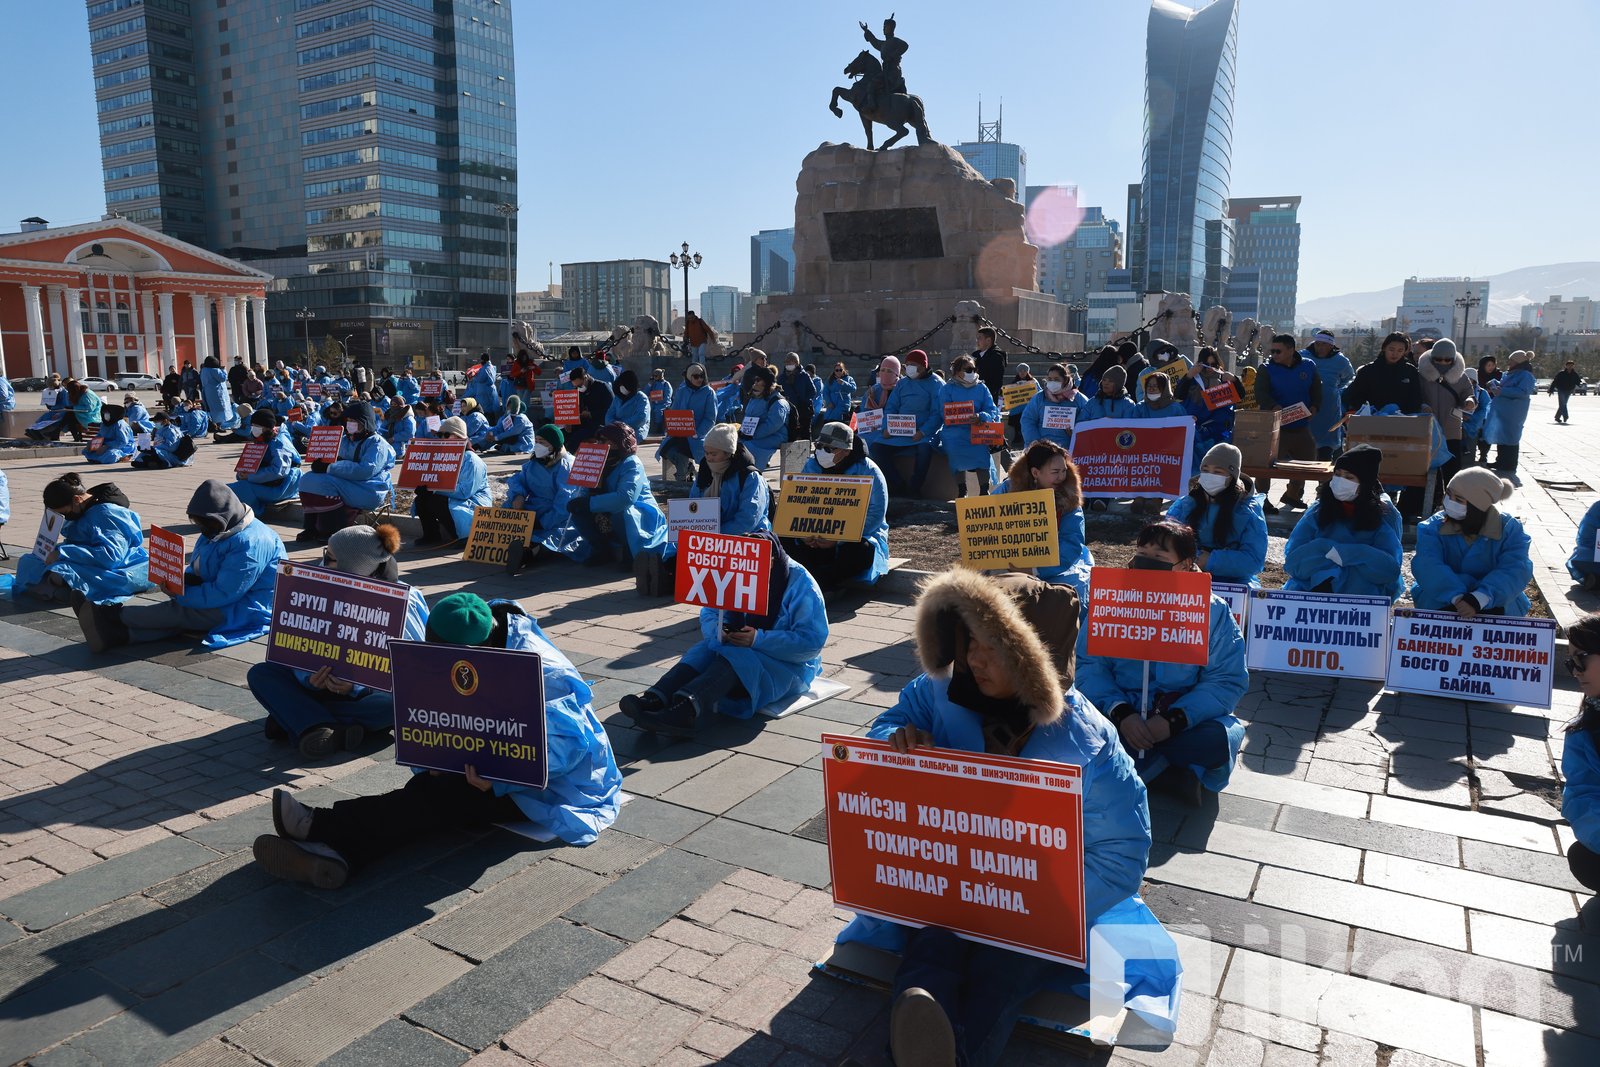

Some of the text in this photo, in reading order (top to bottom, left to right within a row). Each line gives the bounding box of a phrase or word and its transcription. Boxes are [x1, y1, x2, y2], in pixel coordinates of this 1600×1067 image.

[407, 462, 457, 472] УЛСЫН ТӨСВӨӨС
[409, 452, 461, 462] УРСГАЛ ЗАРДЛЫГ
[1073, 453, 1180, 466] БИДНИЙ ЦАЛИН БАНКНЫ
[421, 473, 438, 482] ГАРГА.
[1088, 465, 1161, 475] ЗЭЭЛИЙН БОСГО
[1083, 476, 1128, 487] ДАВАХГҮЙ
[787, 495, 861, 507] МЭНДИЙН САЛБАРЫГ
[835, 488, 856, 496] ЭРҮҮЛ
[477, 508, 530, 522] ЭМЧ, СУВИЛАГЧ,
[808, 506, 834, 516] ОНЦГОЙ
[965, 501, 1047, 520] АЖИЛ ХИЙГЭЭД
[475, 520, 528, 534] АЖИЛТНУУДЫГ
[790, 517, 846, 535] АНХААР!
[966, 517, 1048, 533] ЯДУУРАЛД ӨРТӨЖ БУЙ
[472, 531, 494, 545] ДОРД
[688, 535, 760, 558] СУВИЛАГЧ
[967, 531, 1049, 546] ТӨРИЙН БОДЛОГЫГ
[687, 551, 759, 573] РОБОТ БИШ
[968, 545, 1050, 560] ЭСЭРГҮҮЦЭЖ БАЙНА
[685, 566, 758, 611] ХҮН
[1094, 588, 1143, 603] ИРГЭДИЙН
[1146, 592, 1206, 608] БУХИМДАЛ,
[290, 591, 390, 627] ЭРҮҮЛ МЭНДИЙН
[1093, 605, 1205, 623] ДОРОМЖЛОЛЫГ ТЭВЧИН
[1267, 605, 1371, 626] ҮР ДҮНГИЙН
[279, 611, 332, 636] САЛБАРТ
[337, 624, 359, 642] ЭРХ
[1092, 622, 1203, 645] ЗҮТГЭСЭЭР БАЙНА
[1254, 624, 1382, 648] УРАМШУУЛЛЫГ
[1410, 623, 1537, 646] БИДНИЙ ЦАЛИН
[274, 632, 391, 674] ШИНЭЧЛЭЛ ЭХЛҮҮЛ.
[1288, 648, 1344, 670] ОЛГО.
[1397, 638, 1549, 665] БАНКНЫ ЗЭЭЛИЙН
[1401, 655, 1541, 683] БОСГО ДАВАХГҮЙ
[1440, 677, 1495, 696] БАЙНА.
[408, 708, 527, 738] ХӨДӨЛМӨРИЙГ
[402, 727, 536, 761] БОДИТООР ҮНЭЛ!
[855, 751, 1074, 789] "ЭРҮҮЛ МЭНДИЙН САЛБАРЫН ЗӨВ ШИНЭЧЛЭЛИЙН ТӨЛӨӨ"
[837, 792, 1067, 850] ХИЙСЭН ХӨДӨЛМӨРТӨӨ
[864, 829, 1037, 881] ТОХИРСОН ЦАЛИН
[876, 864, 1030, 915] АВМААР БАЙНА.
